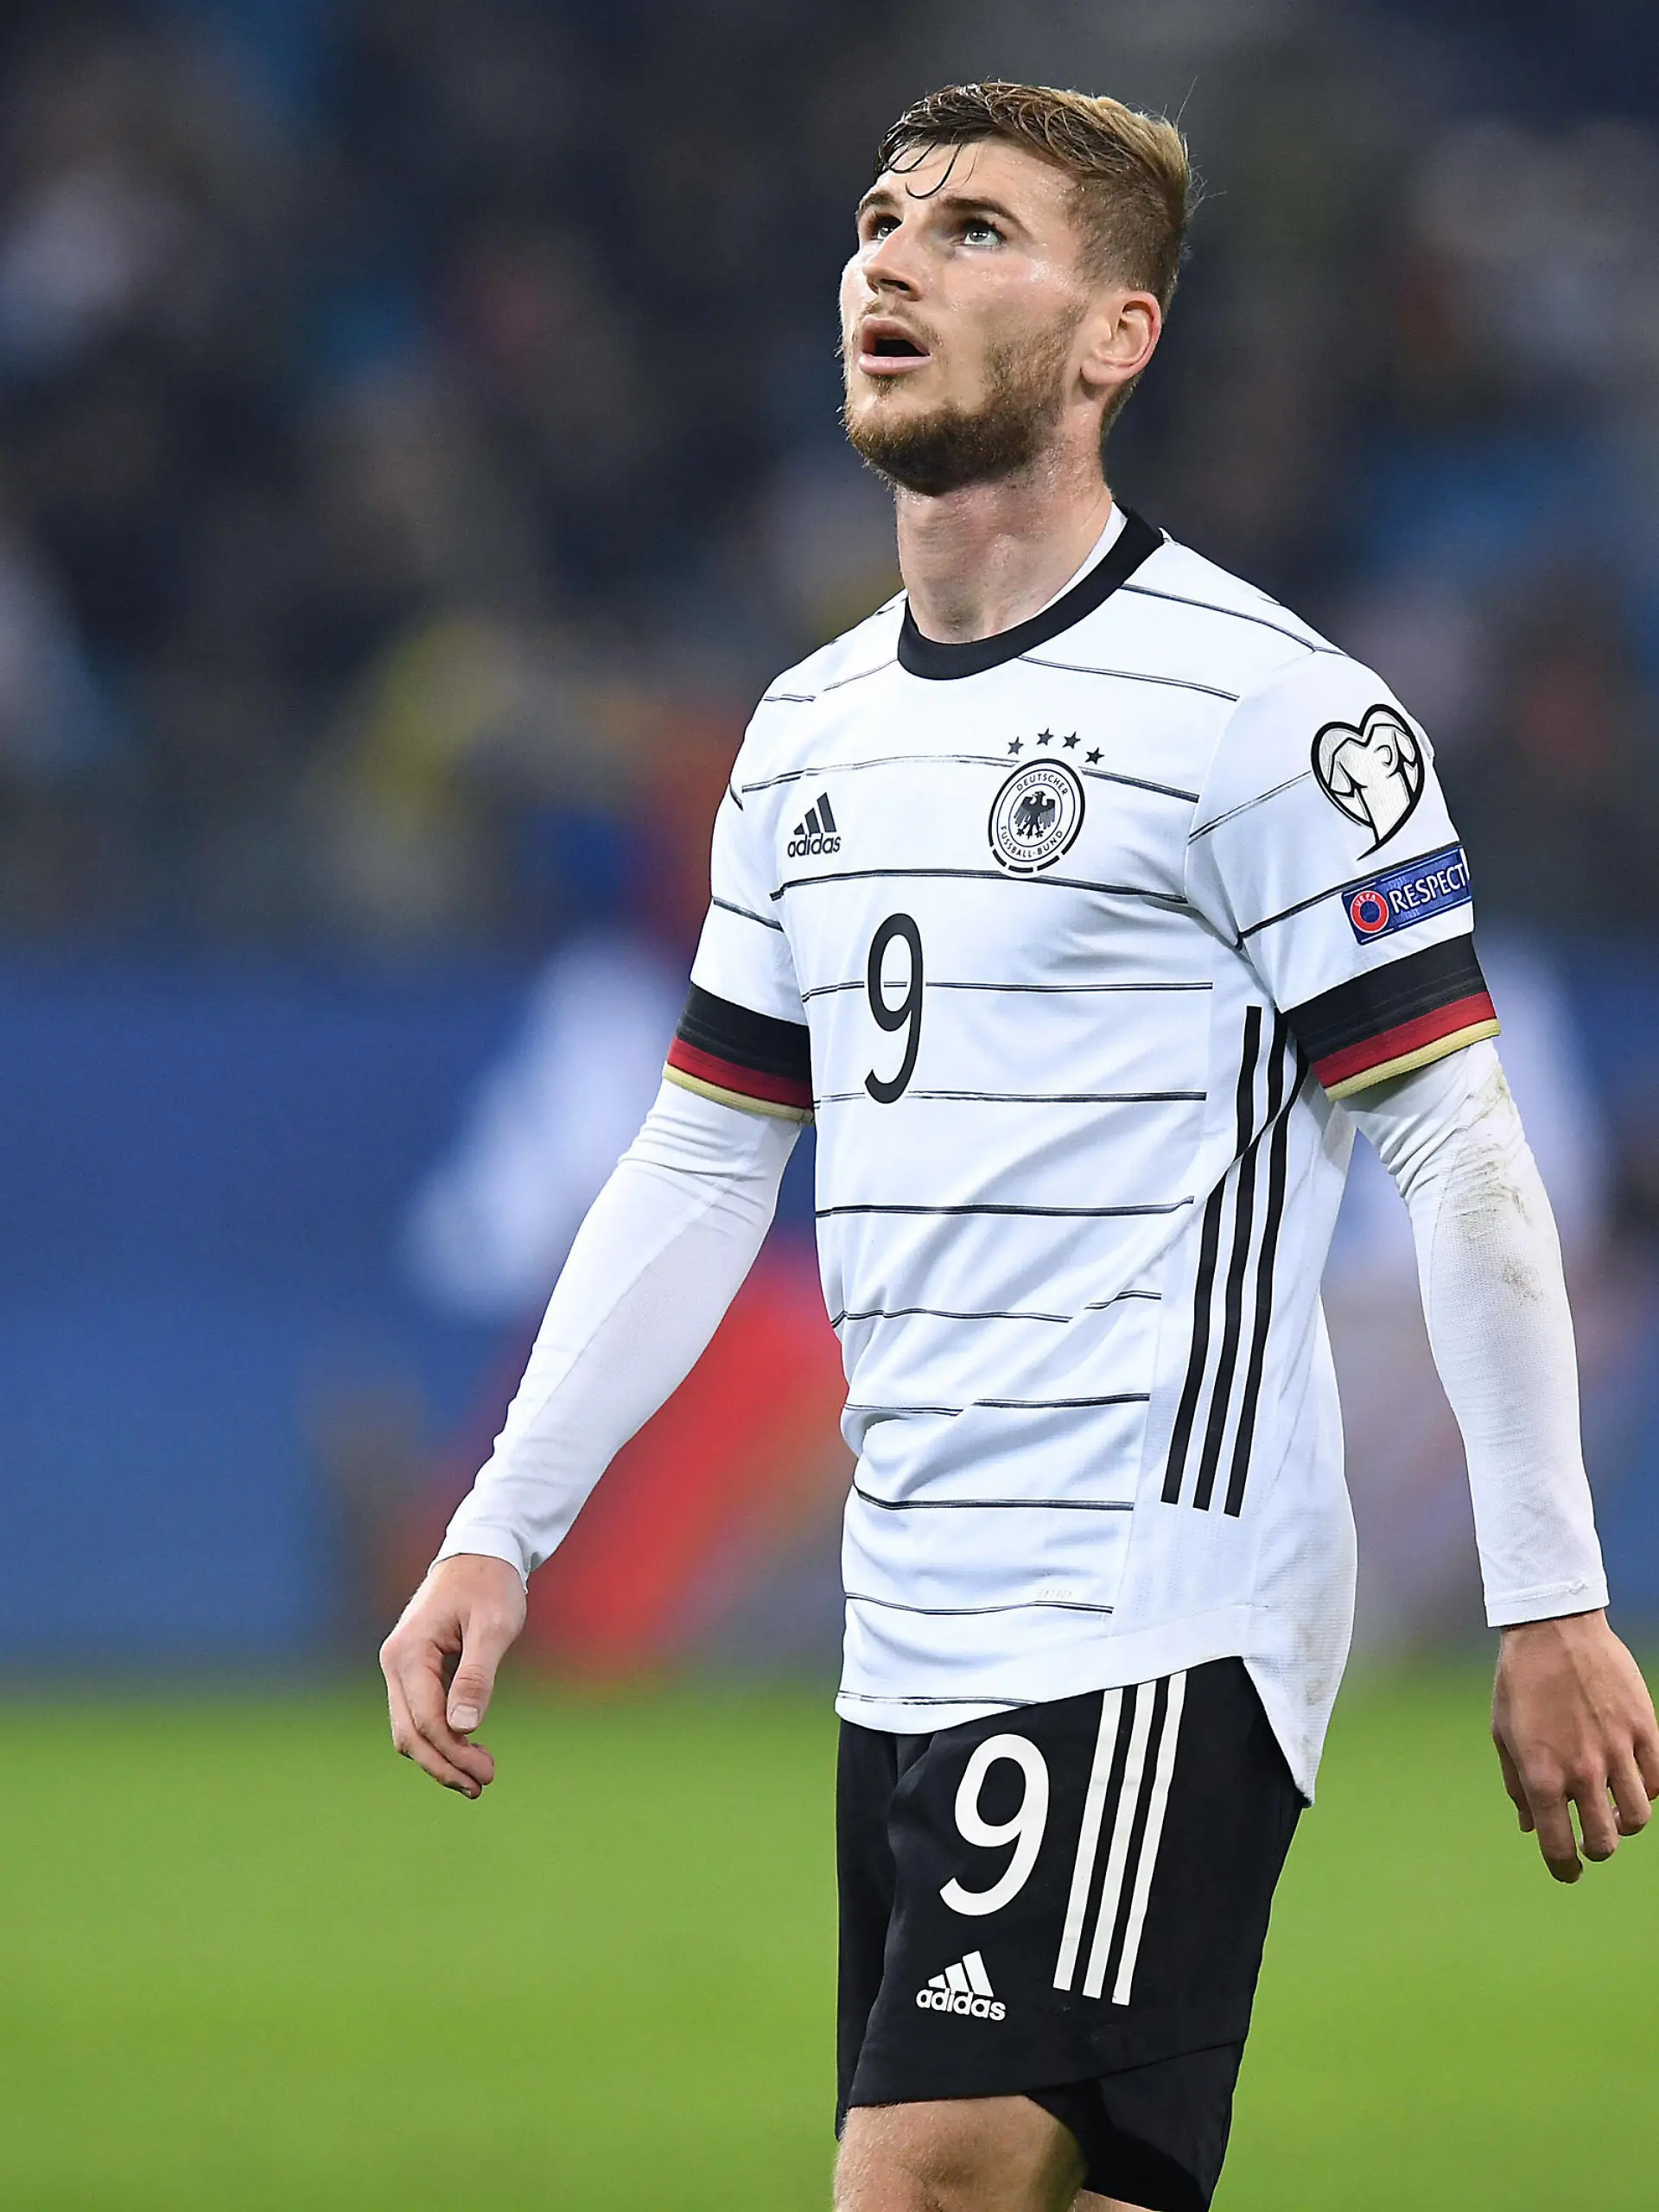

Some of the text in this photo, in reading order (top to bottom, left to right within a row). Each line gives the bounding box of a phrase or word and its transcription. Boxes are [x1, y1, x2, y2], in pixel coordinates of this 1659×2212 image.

[1016, 773, 1069, 796] DEUTSCHER
[787, 834, 842, 857] adidas
[1389, 863, 1466, 913] RESPECT
[864, 912, 924, 1104] 9
[939, 1733, 1050, 1916] 9
[916, 1987, 1007, 2021] adidas
